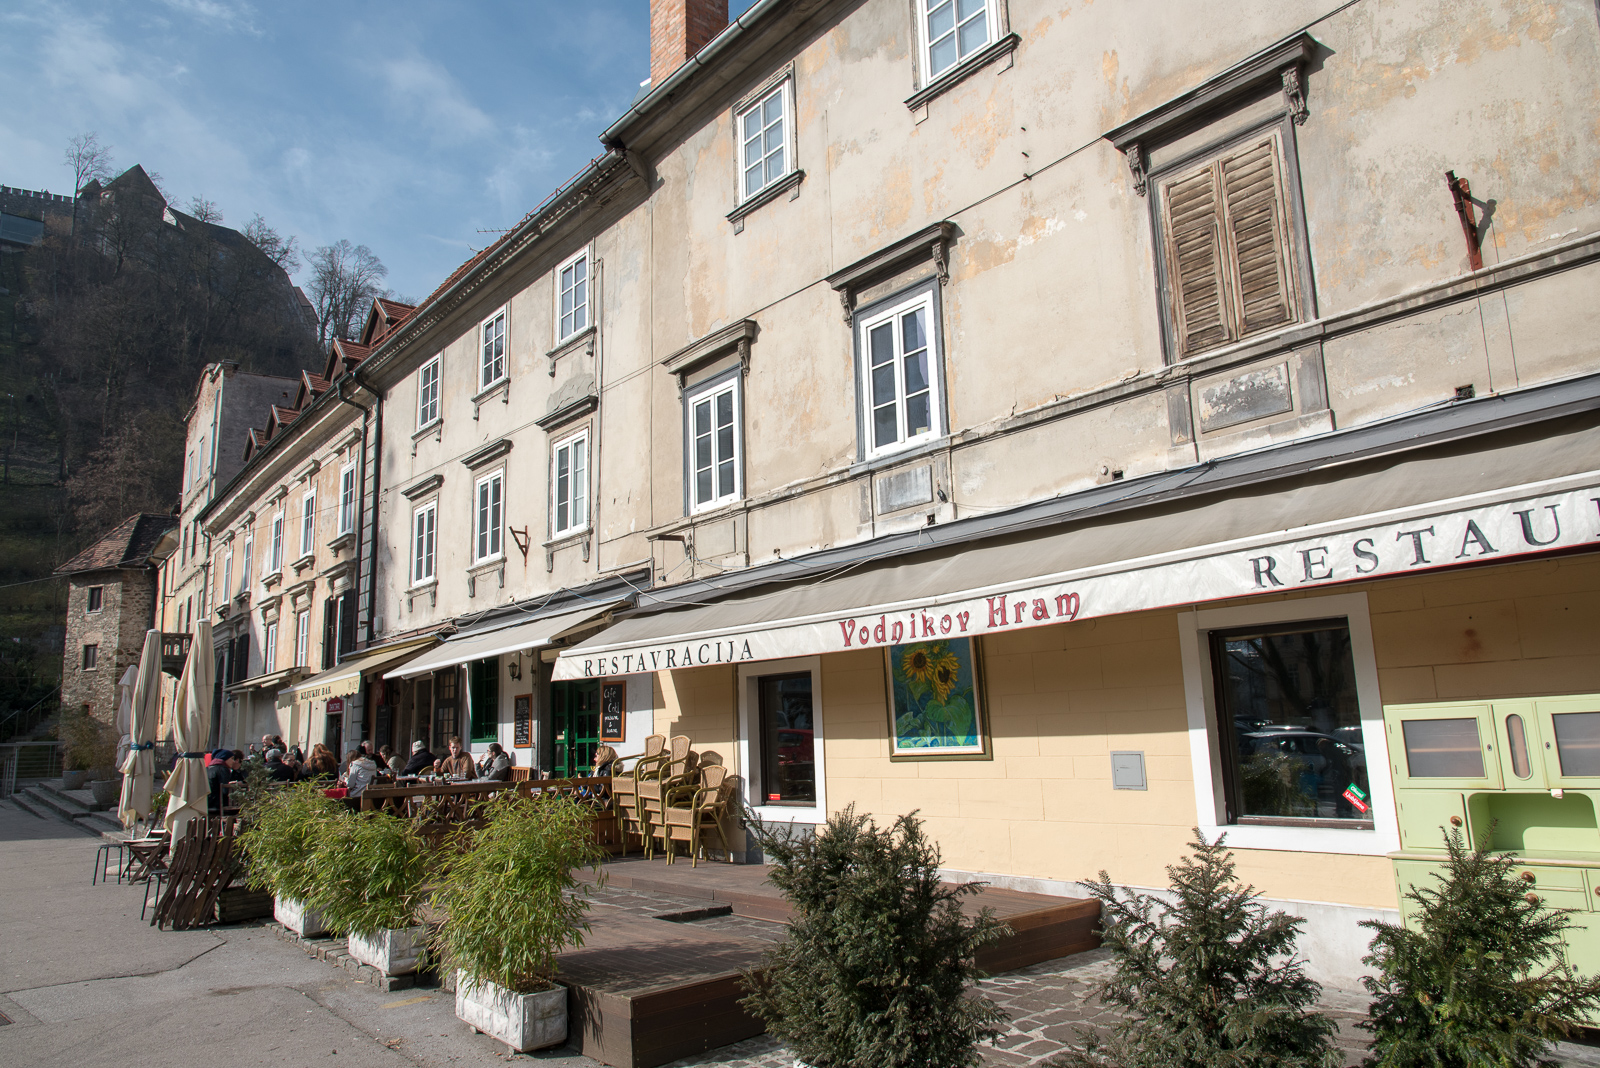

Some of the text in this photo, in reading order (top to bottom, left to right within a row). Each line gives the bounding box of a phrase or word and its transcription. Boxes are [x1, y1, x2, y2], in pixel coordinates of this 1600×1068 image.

[839, 592, 1081, 647] Vodnikov Hram
[584, 639, 754, 677] RESTAVRACIJA
[322, 686, 331, 695] BAR
[1345, 791, 1365, 810] Ljubljane
